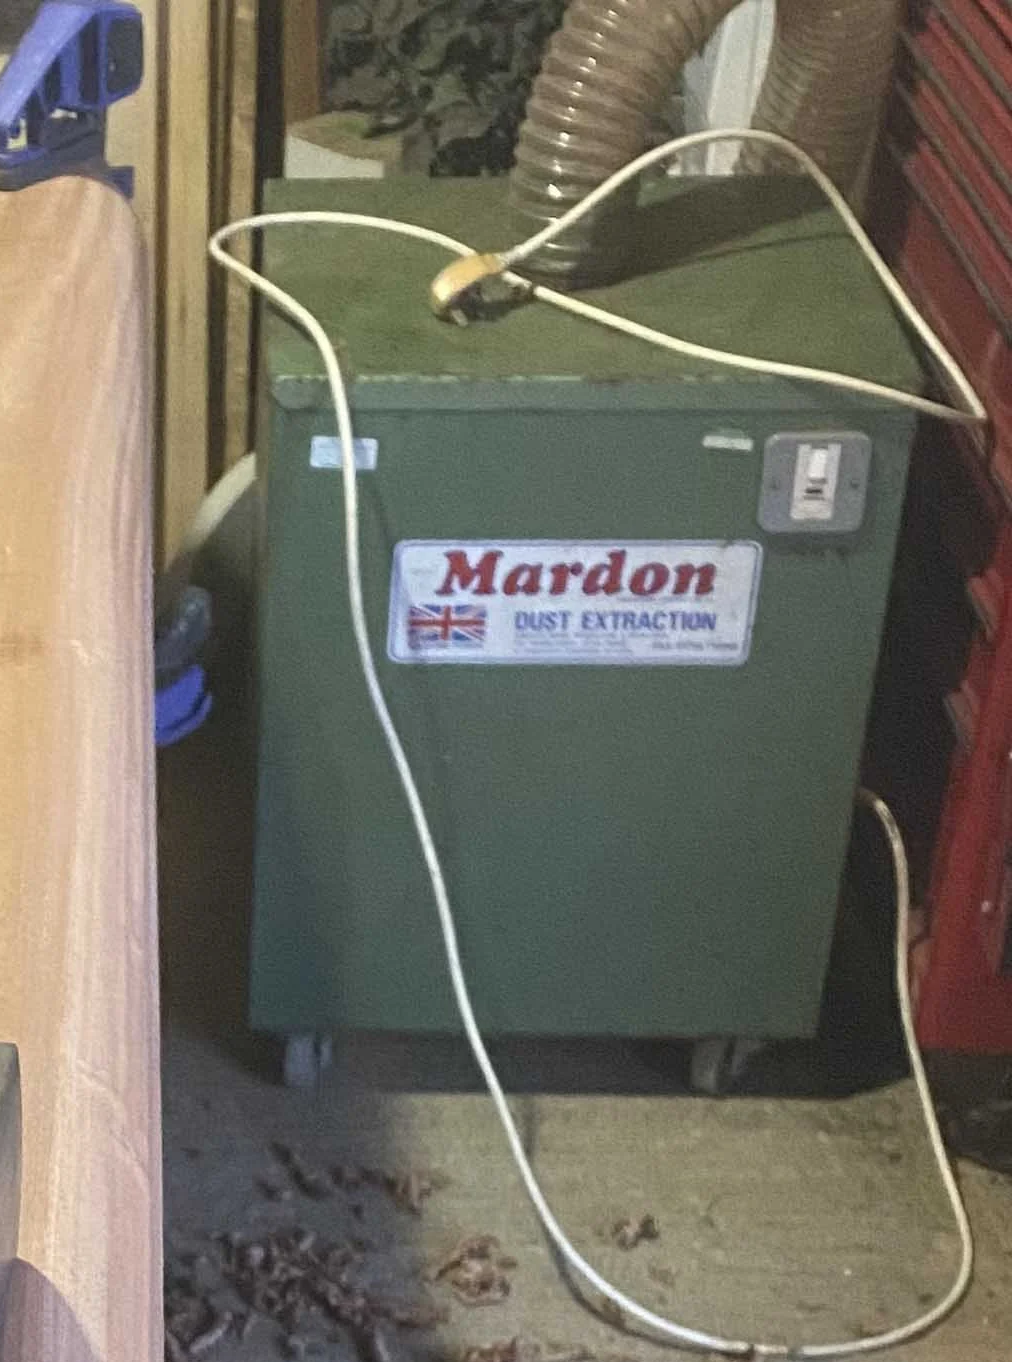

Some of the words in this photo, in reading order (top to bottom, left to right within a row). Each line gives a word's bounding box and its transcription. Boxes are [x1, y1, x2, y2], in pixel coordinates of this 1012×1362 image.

[436, 549, 717, 597] Mardon
[515, 610, 571, 630] DUST
[581, 611, 717, 631] EXTRACTION
